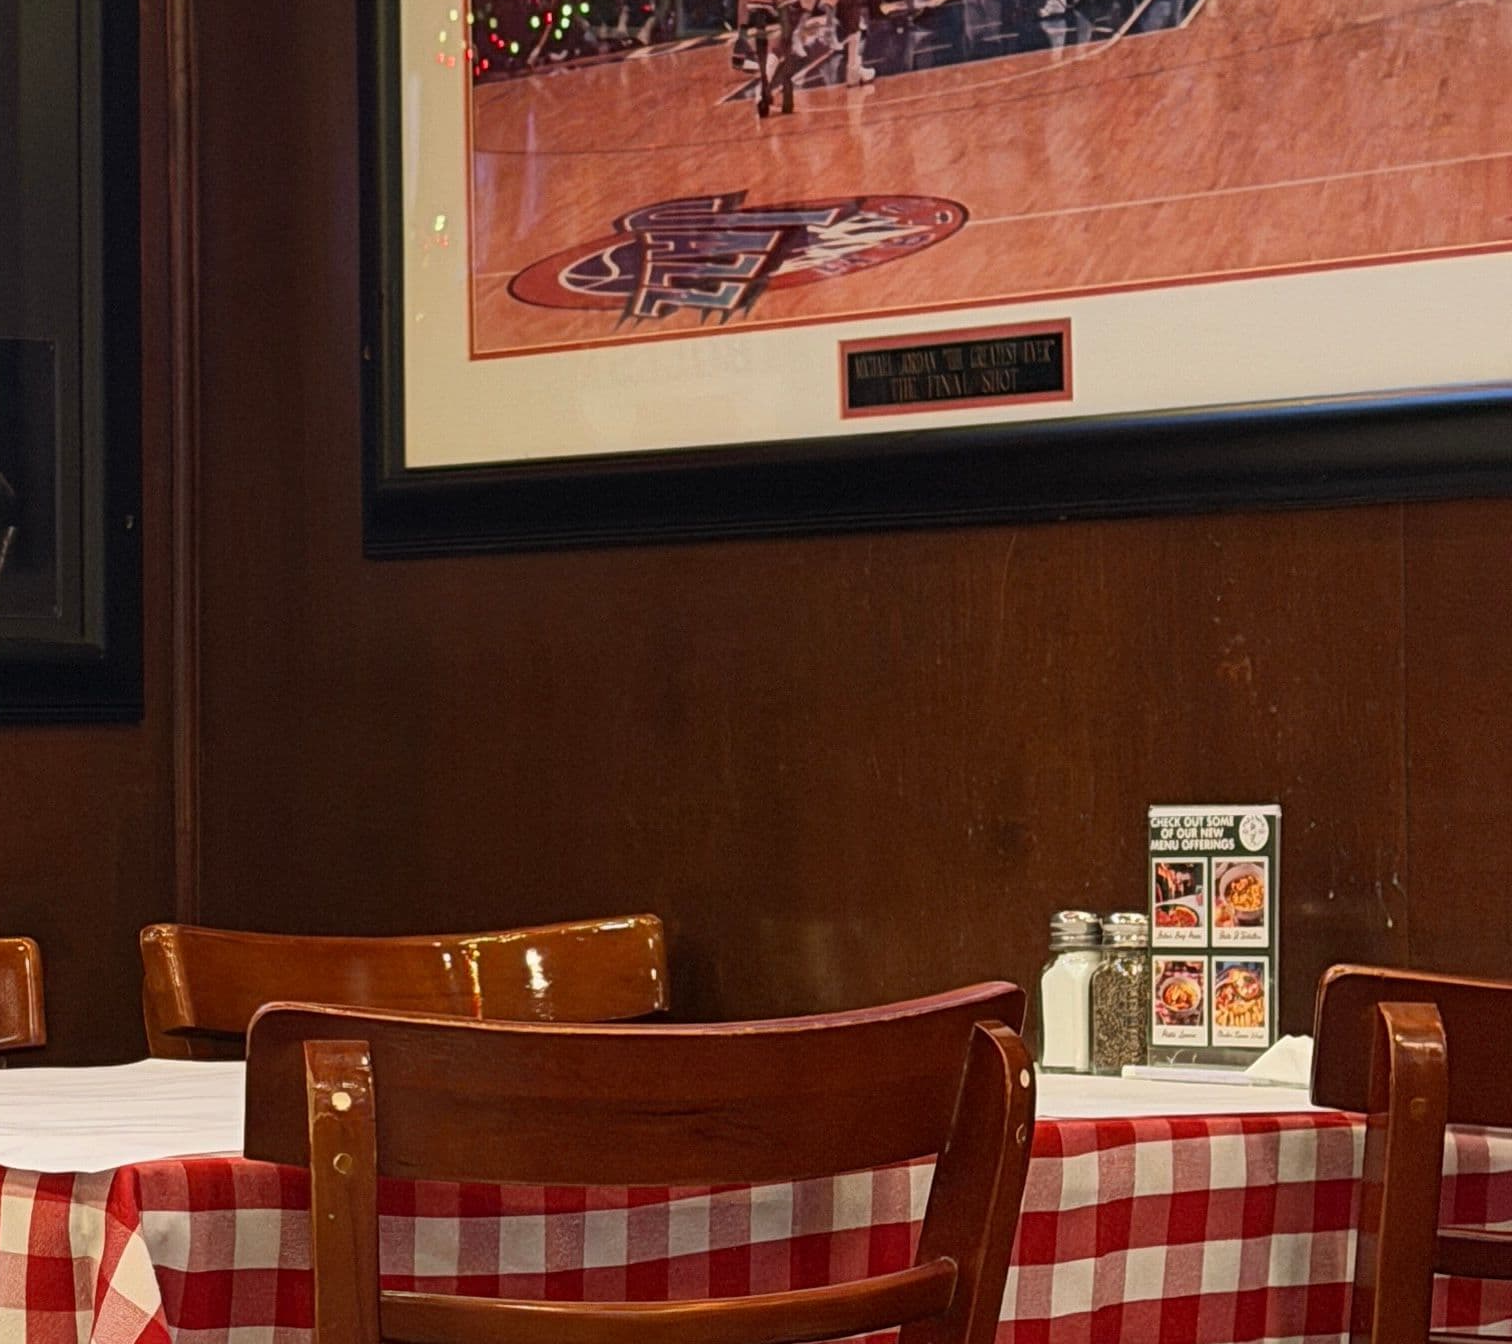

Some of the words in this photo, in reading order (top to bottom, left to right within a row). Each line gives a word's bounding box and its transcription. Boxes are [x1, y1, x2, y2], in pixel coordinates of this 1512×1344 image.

[1150, 815, 1181, 828] CHECK
[1183, 815, 1204, 827] OUT
[1206, 815, 1234, 827] SOME
[1160, 827, 1174, 839] OF
[1176, 827, 1198, 839] OUR
[1200, 827, 1224, 838] NEW
[1150, 839, 1179, 851] MENU
[1181, 838, 1235, 850] OFFERINGS
